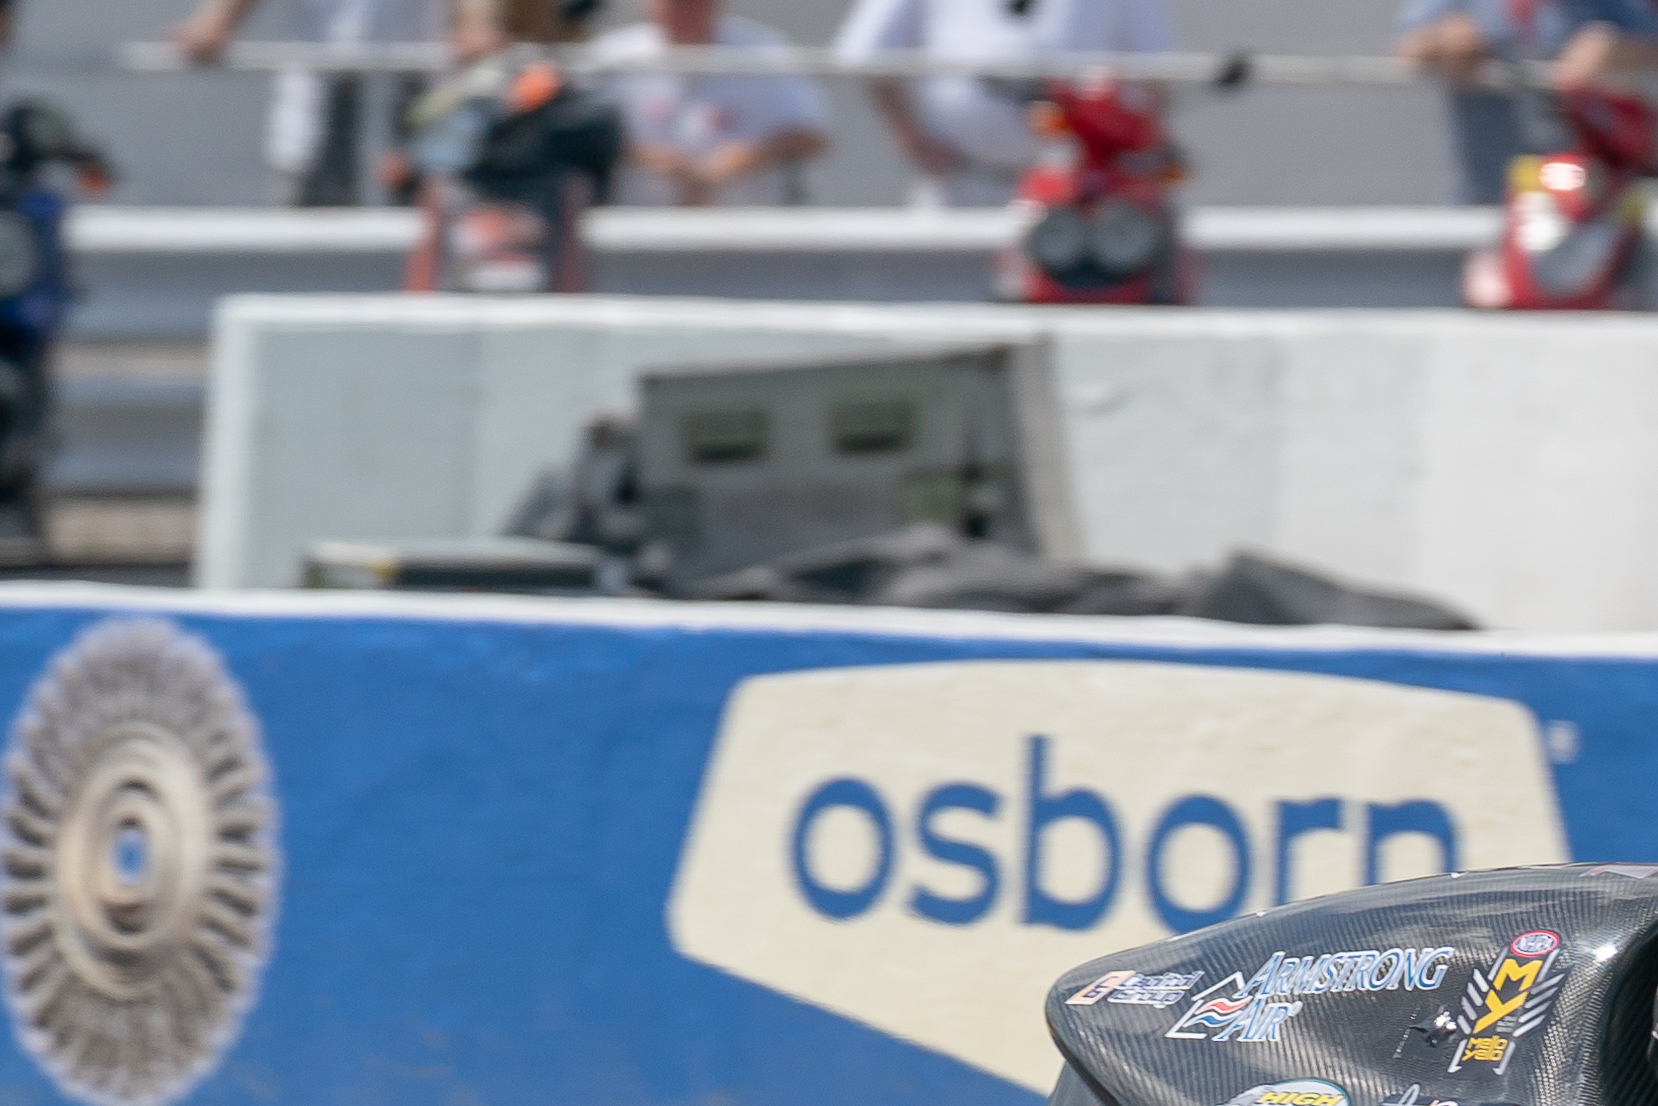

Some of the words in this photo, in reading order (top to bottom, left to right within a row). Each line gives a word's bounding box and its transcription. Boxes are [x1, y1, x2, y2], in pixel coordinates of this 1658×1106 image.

[782, 735, 1467, 932] osborn
[1233, 947, 1454, 999] ARMSTRONG
[1212, 999, 1298, 1042] AIR
